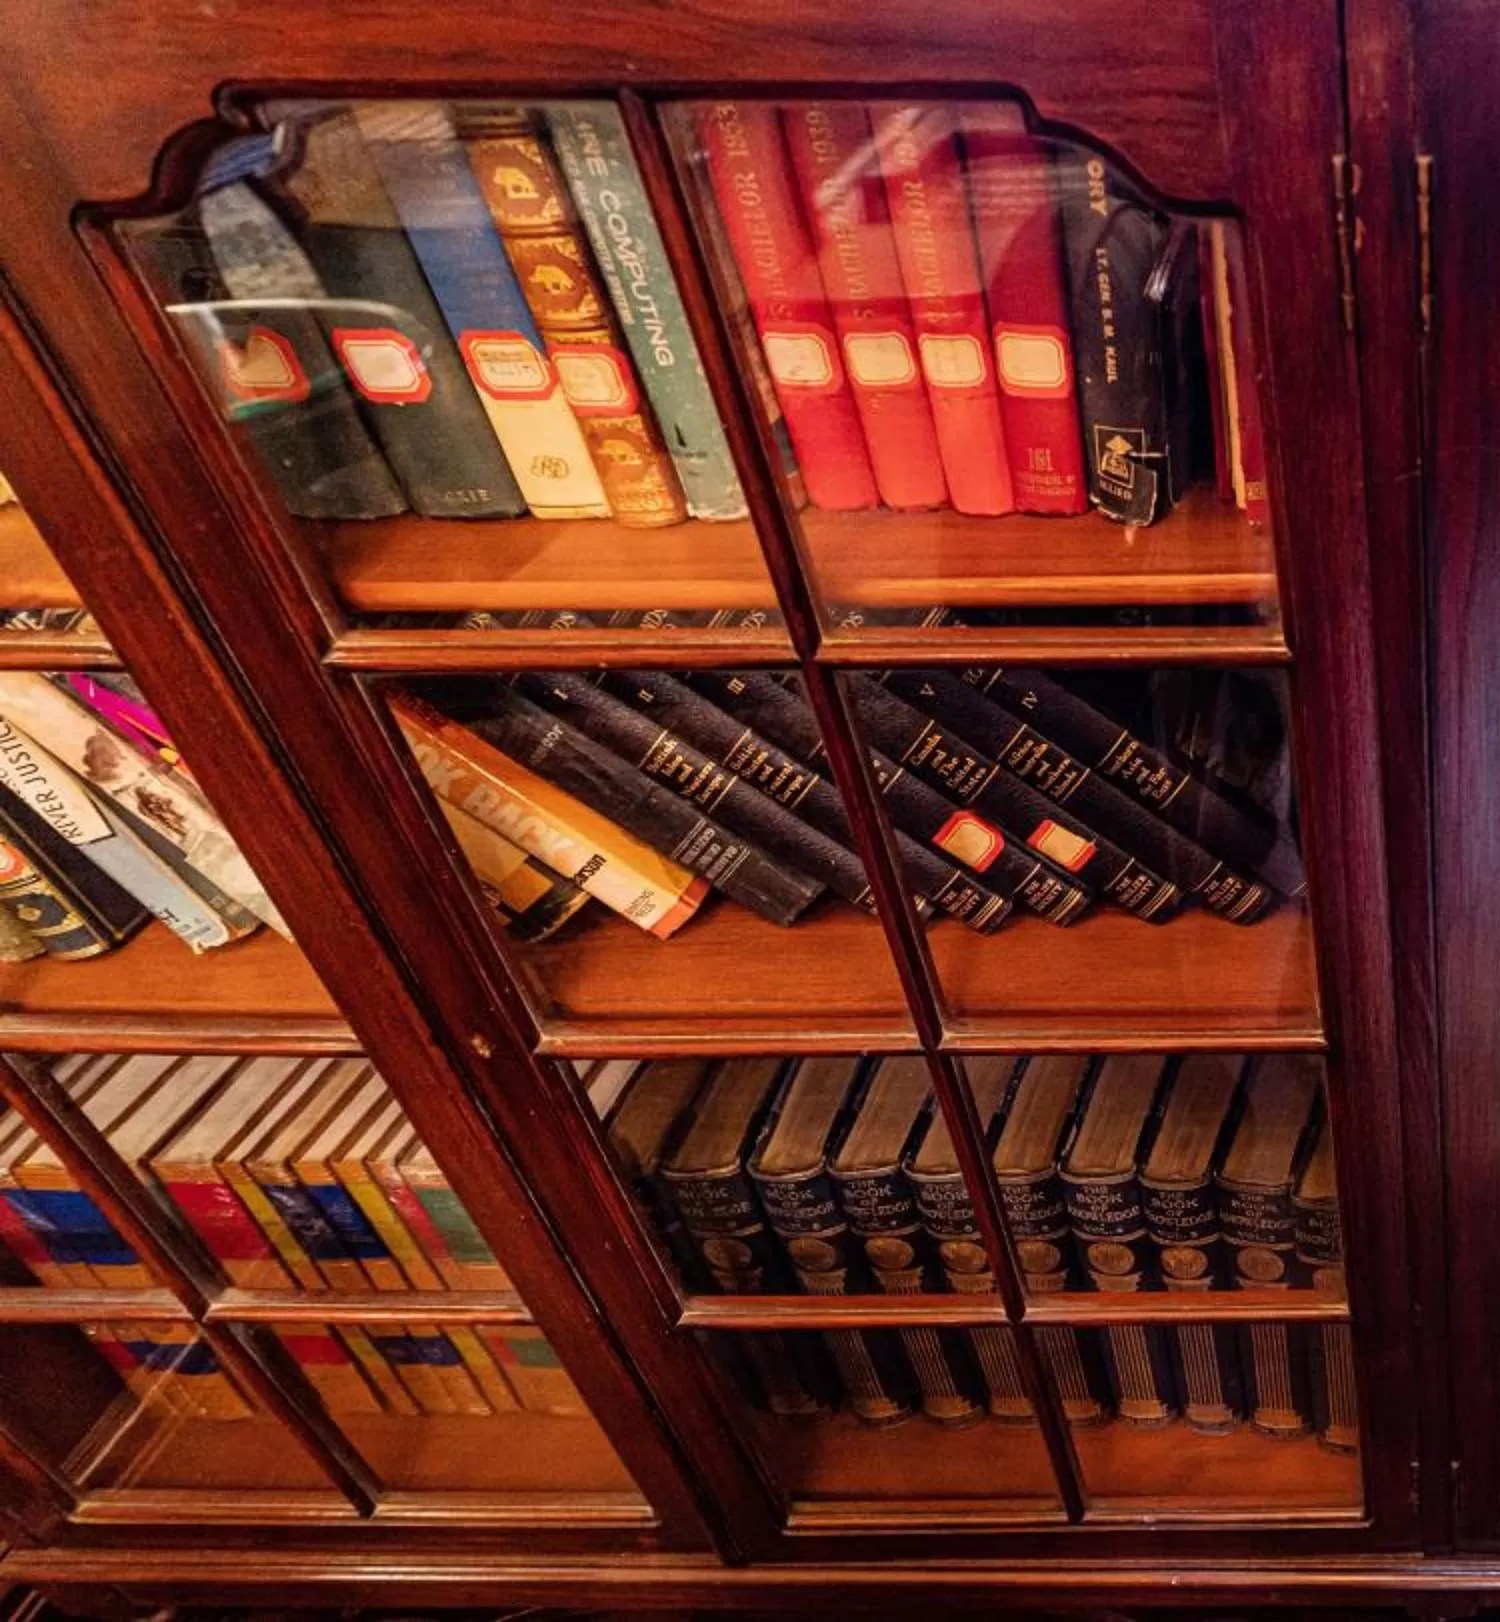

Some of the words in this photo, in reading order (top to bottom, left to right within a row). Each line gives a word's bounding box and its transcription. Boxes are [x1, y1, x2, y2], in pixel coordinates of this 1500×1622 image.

[715, 104, 750, 157] 1953
[599, 189, 674, 368] COMPUTING
[0, 720, 47, 784] JUSTIC
[35, 789, 83, 839] RIVER
